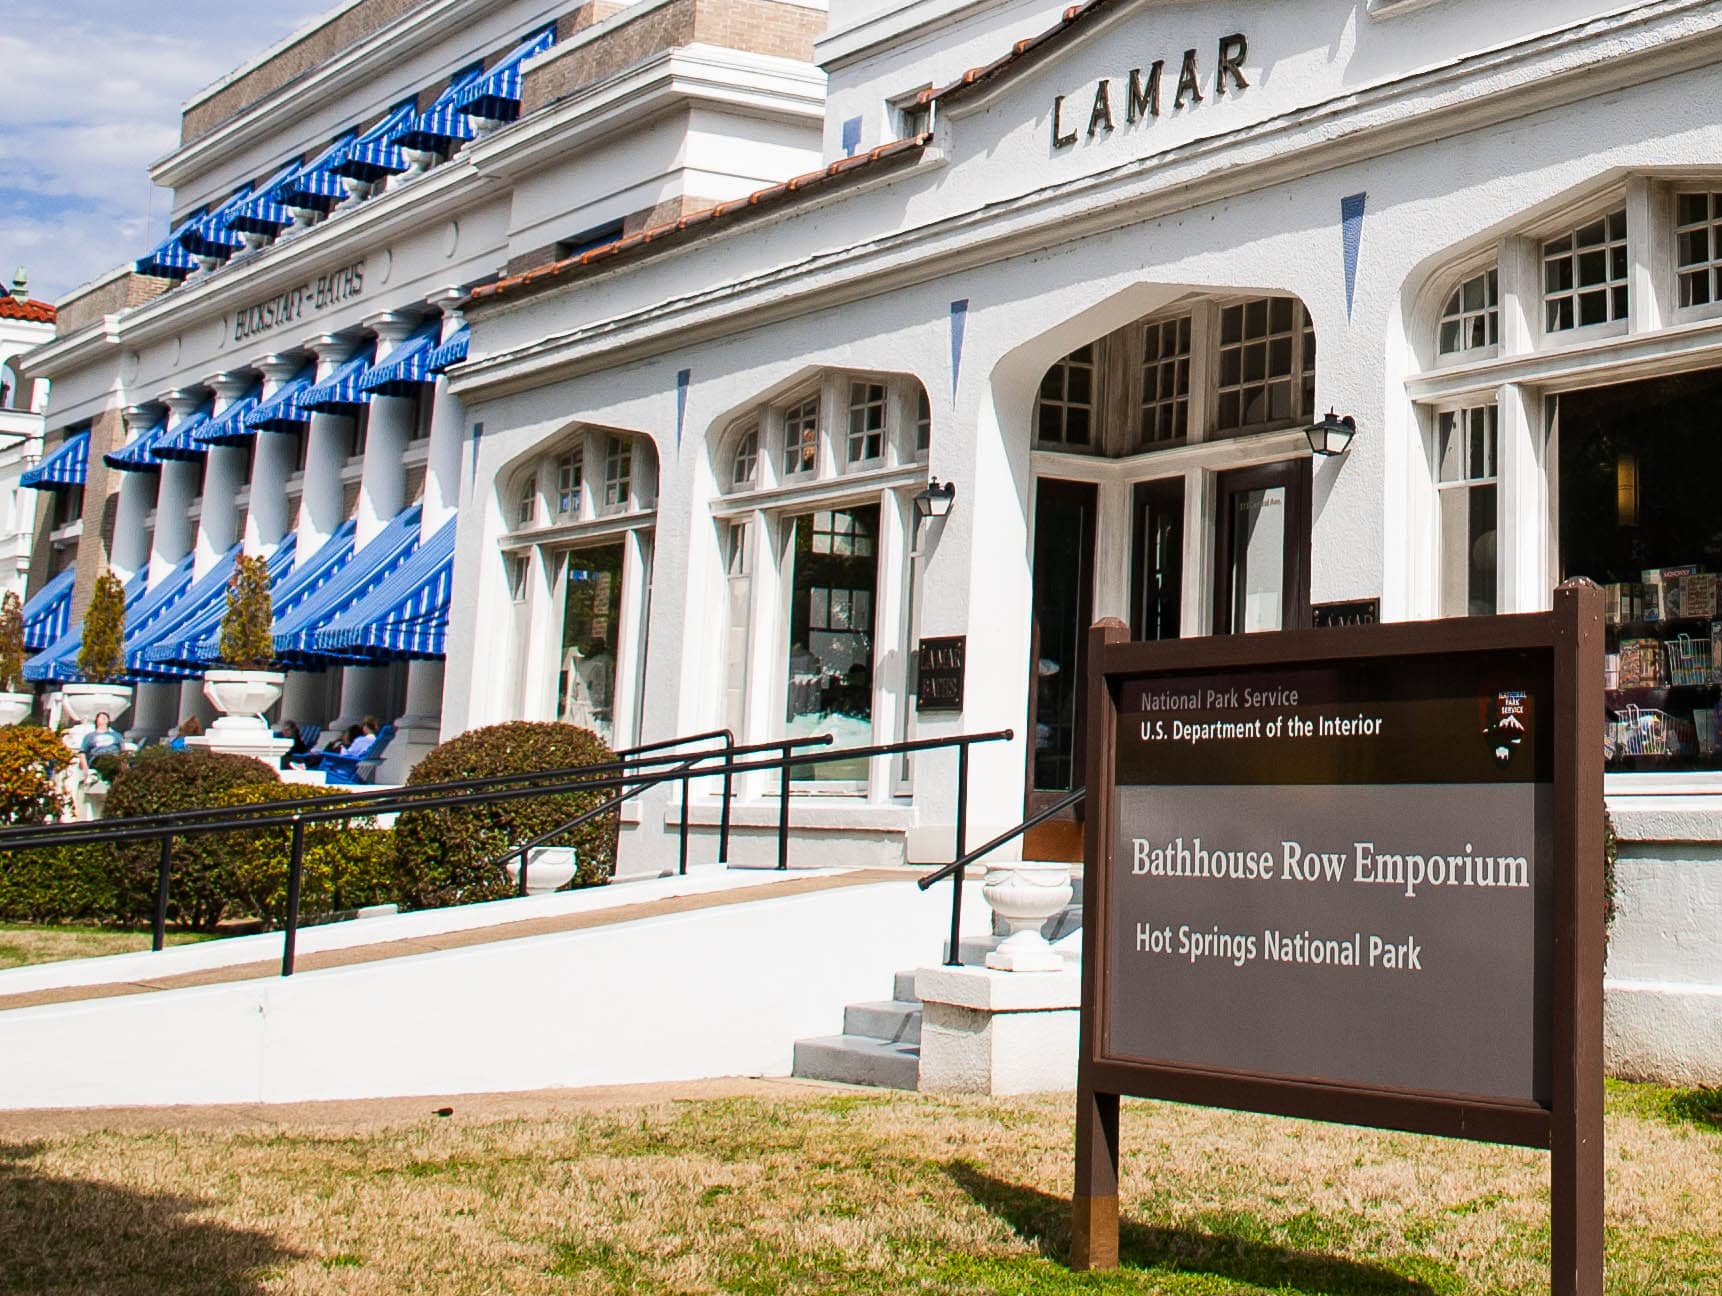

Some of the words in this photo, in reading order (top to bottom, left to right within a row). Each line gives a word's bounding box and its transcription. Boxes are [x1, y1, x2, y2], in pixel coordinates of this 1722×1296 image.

[1052, 32, 1250, 149] LAMAR
[1141, 689, 1202, 712] National
[1206, 687, 1239, 709] Park
[1244, 685, 1299, 708] Service
[1140, 719, 1168, 741] U.S.
[1173, 718, 1261, 744] Department
[1266, 715, 1283, 738] of
[1287, 714, 1314, 737] the
[1319, 713, 1382, 736] Interior
[1131, 837, 1274, 880] Bathhouse
[1280, 841, 1347, 882] Row
[1353, 842, 1530, 897] Emporium
[1136, 922, 1172, 953] Hot
[1178, 925, 1257, 967] Springs
[1264, 930, 1361, 966] National
[1369, 935, 1422, 970] Park
